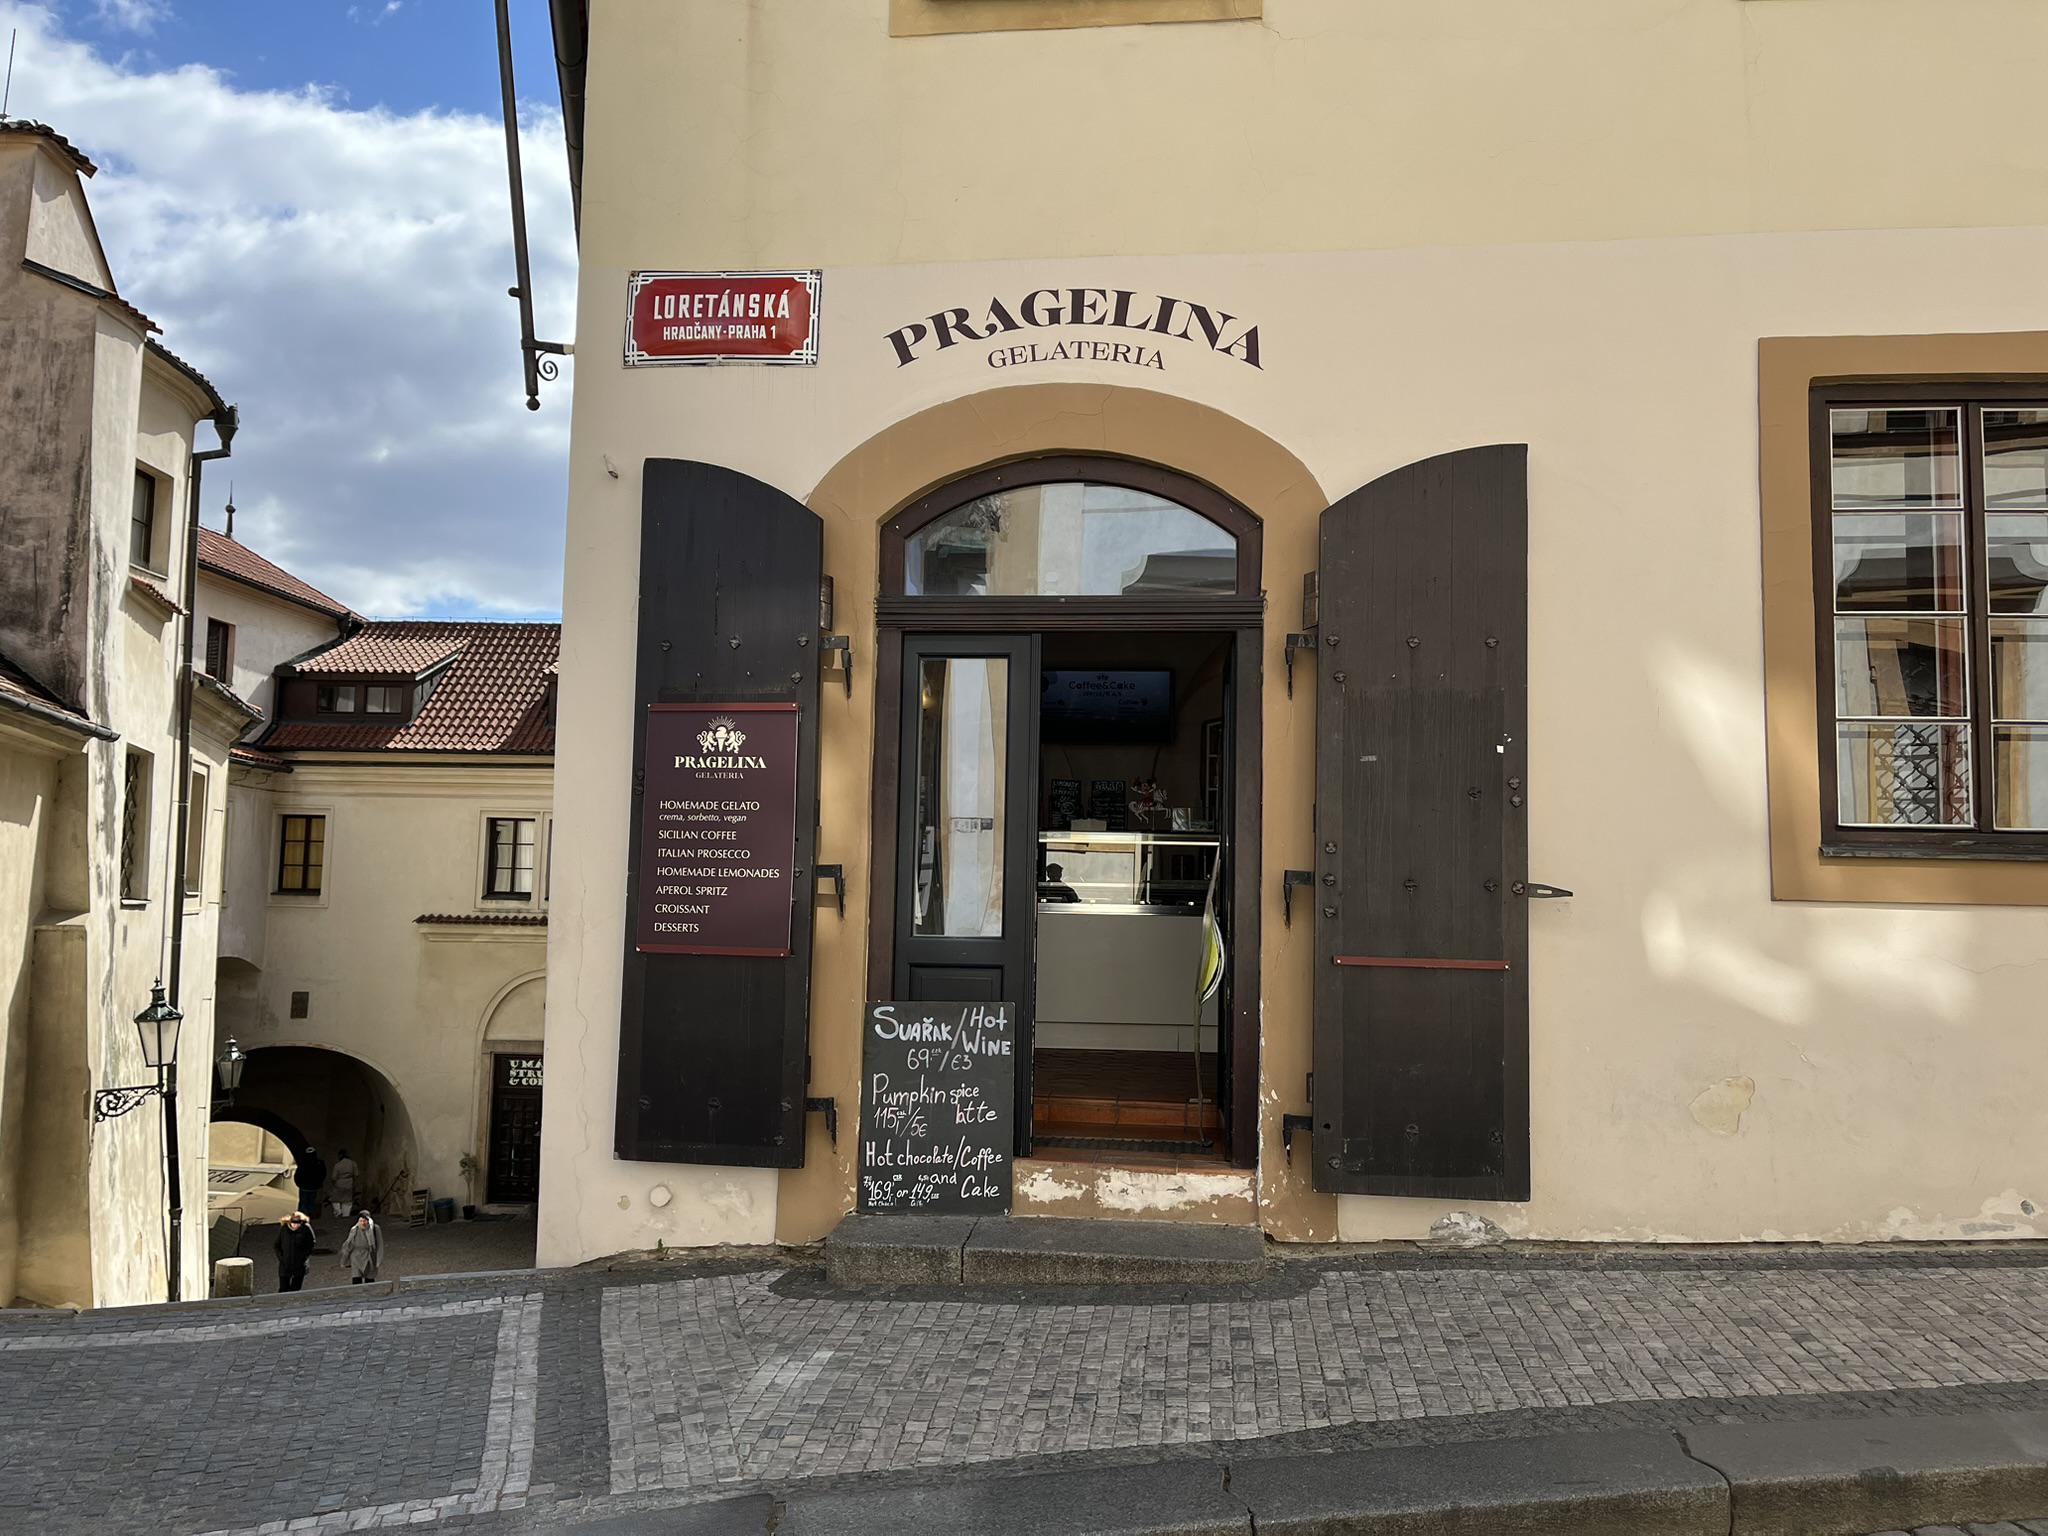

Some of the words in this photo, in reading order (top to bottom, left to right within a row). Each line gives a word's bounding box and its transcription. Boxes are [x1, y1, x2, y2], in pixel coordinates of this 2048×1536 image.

[653, 289, 790, 320] LORETÁNSKÁ
[770, 325, 777, 339] 1
[883, 288, 1264, 371] PRAGELINA
[987, 340, 1166, 371] GELATERIA
[674, 755, 767, 769] PRAGELINA
[695, 771, 744, 780] GELATERIA
[659, 800, 719, 811] HOMEMADE
[721, 800, 760, 811] GELATO
[659, 813, 686, 822] crema,
[687, 812, 721, 823] sorbetto,
[723, 815, 747, 824] vegan
[658, 829, 699, 840] SICILIAN
[700, 830, 737, 841] COFFEE
[657, 848, 695, 859] ITALIAN
[697, 848, 751, 860] PROSECCO
[656, 866, 716, 877] HOMEMADE
[718, 867, 780, 879] LEMONADES
[655, 885, 693, 896] APEROL
[695, 885, 728, 896] SPRITZ
[654, 903, 711, 914] CROISSANT
[654, 922, 700, 933] DESSERTS
[509, 1060, 520, 1068] U
[508, 1077, 520, 1086] &
[872, 1073, 946, 1115] Pumpkin
[949, 1083, 980, 1104] spice
[866, 1139, 894, 1167] Hot
[929, 1172, 958, 1185] and
[896, 1189, 909, 1199] or
[960, 1175, 1001, 1199] Cake
